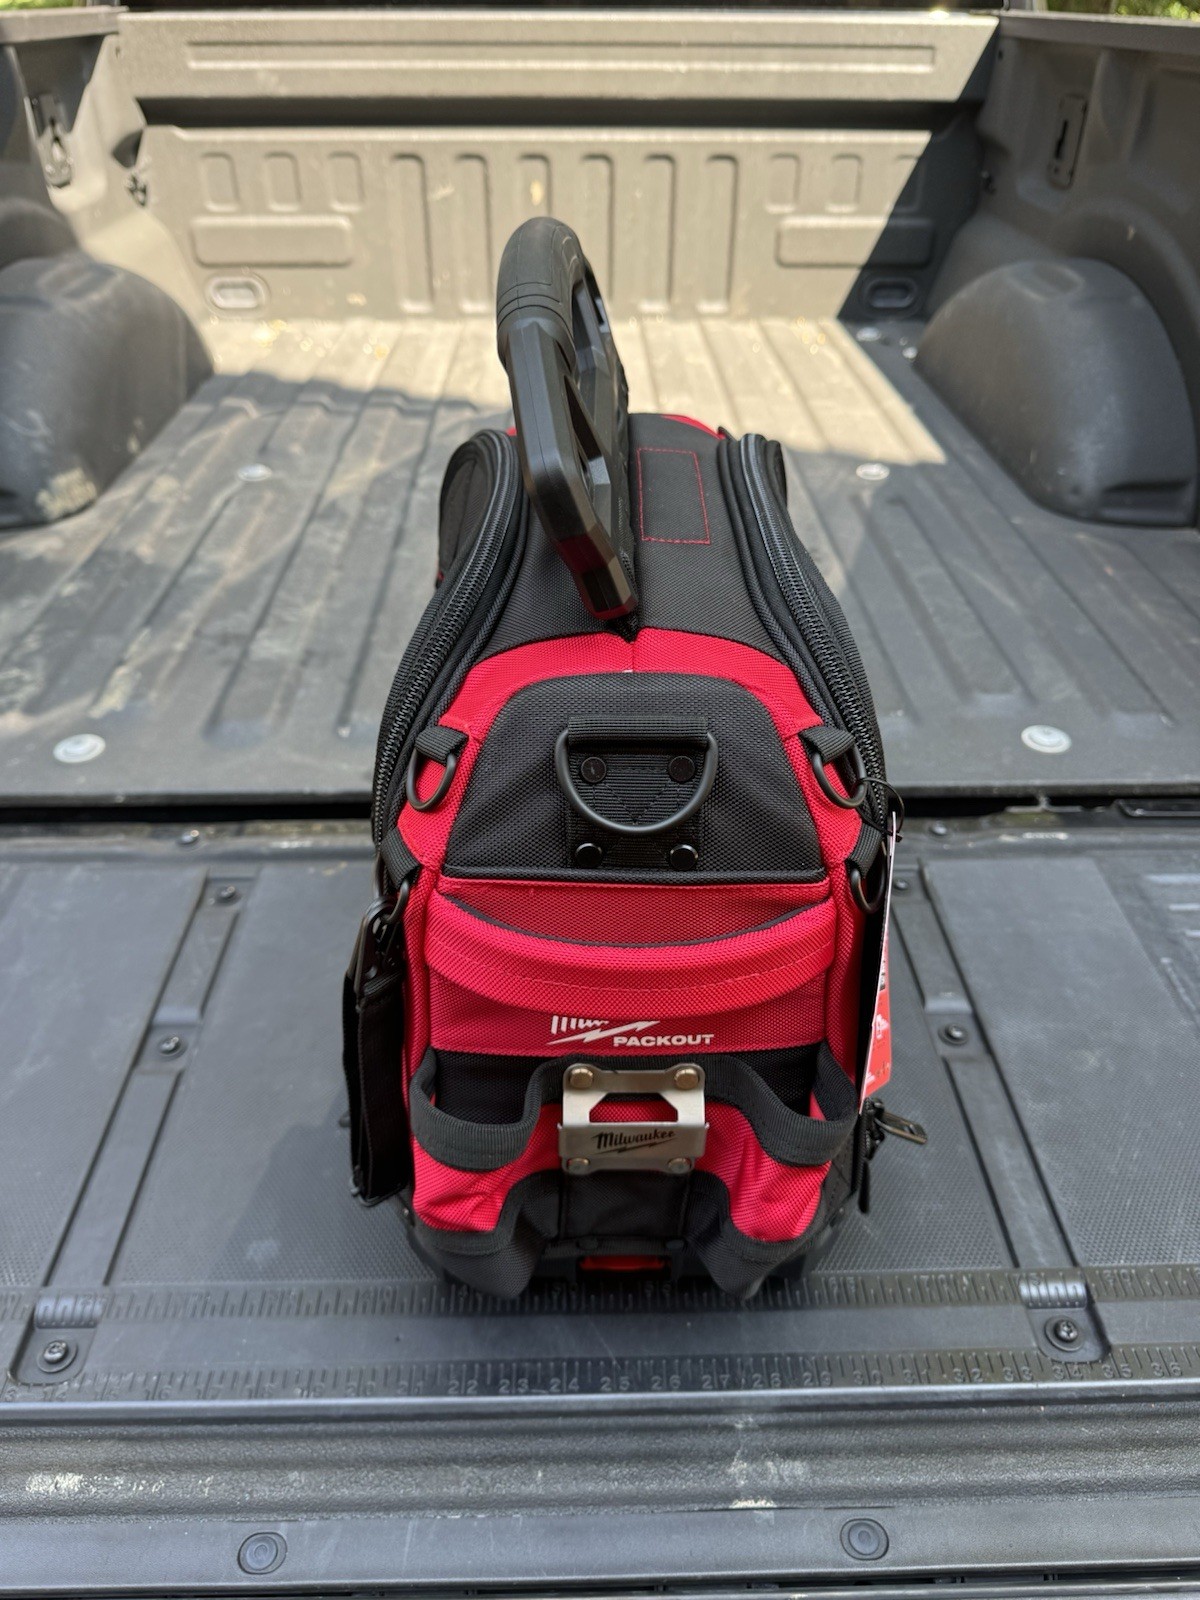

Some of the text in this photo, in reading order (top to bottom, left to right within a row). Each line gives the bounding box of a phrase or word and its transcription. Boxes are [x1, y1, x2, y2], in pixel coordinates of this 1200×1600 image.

[613, 1033, 715, 1048] PACKOUT
[592, 1128, 676, 1150] Milwaukee
[448, 1379, 478, 1395] 22
[498, 1379, 529, 1394] 23
[549, 1377, 580, 1393] 24
[600, 1376, 631, 1391] 25
[650, 1375, 681, 1391] 26
[702, 1374, 730, 1390] 27
[751, 1373, 782, 1388] 28
[953, 1367, 984, 1383] 32
[1002, 1366, 1034, 1382] 33
[1052, 1364, 1083, 1380] 34
[1102, 1362, 1133, 1378] 35
[1151, 1361, 1182, 1377] 36
